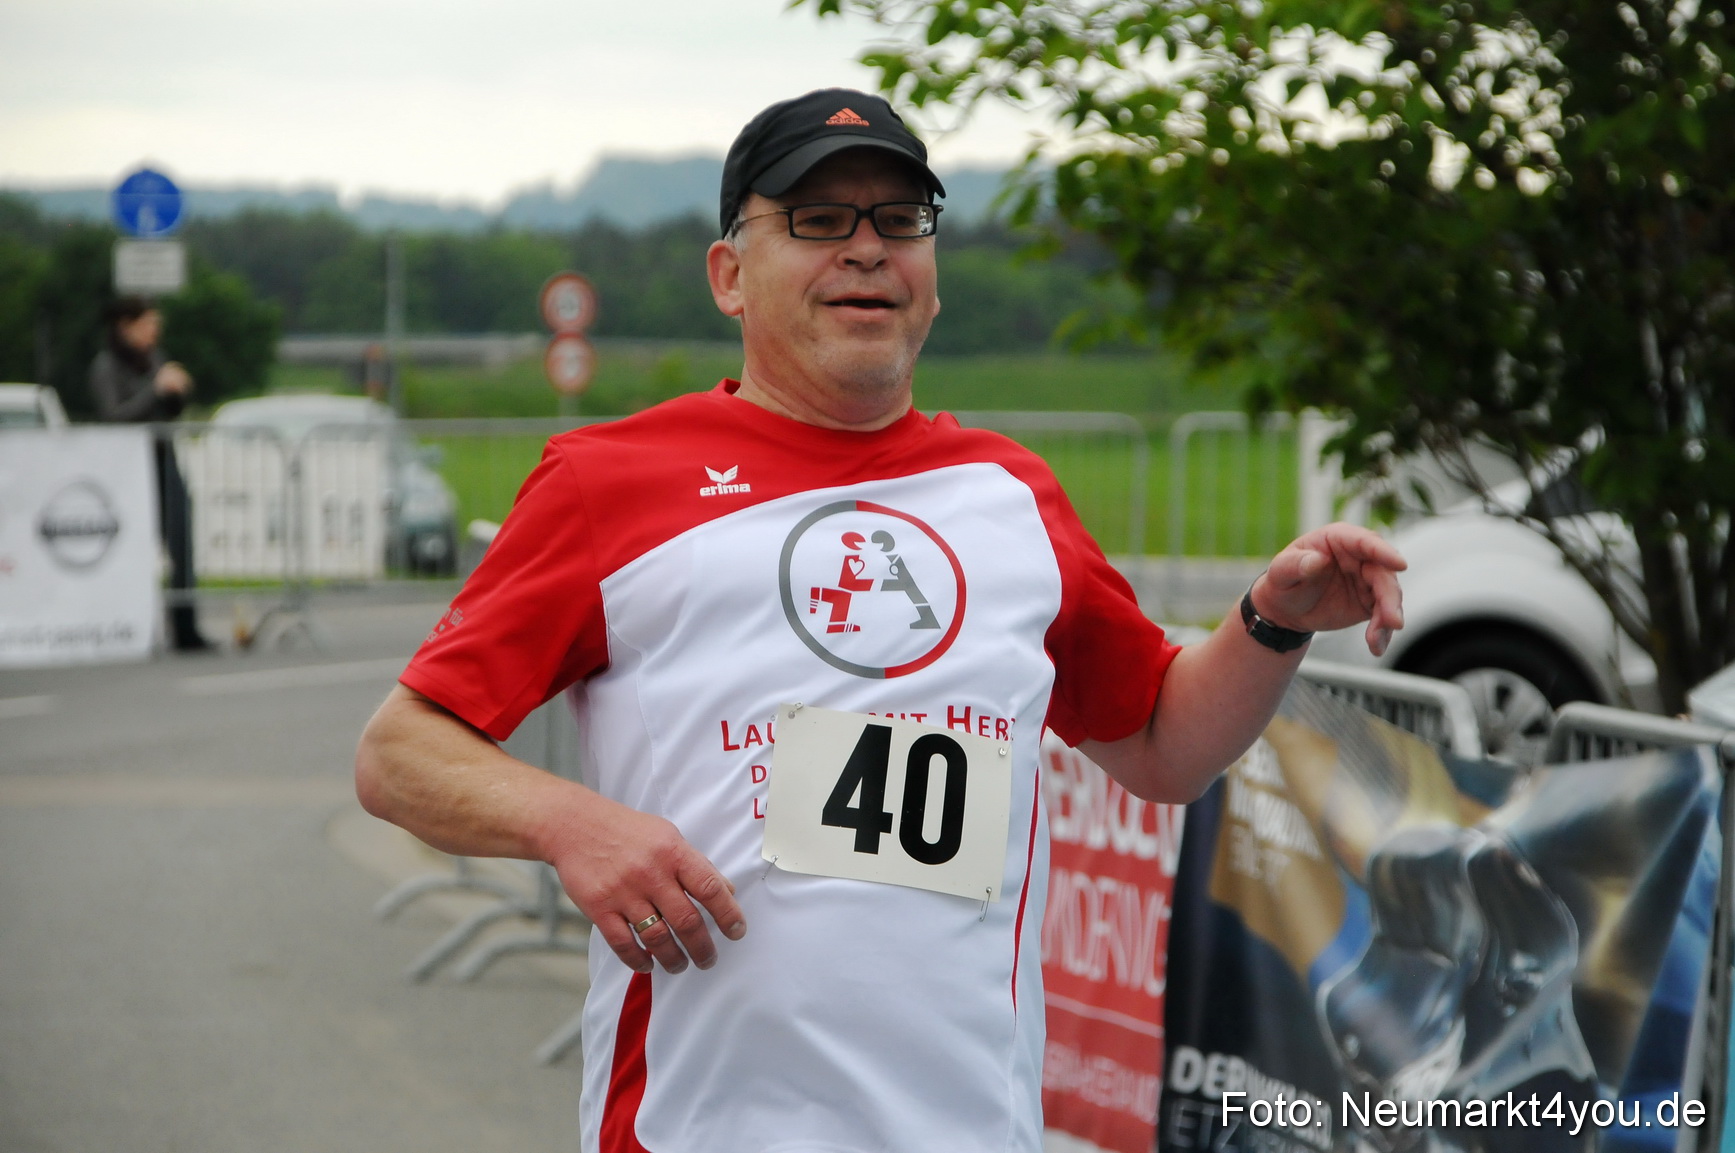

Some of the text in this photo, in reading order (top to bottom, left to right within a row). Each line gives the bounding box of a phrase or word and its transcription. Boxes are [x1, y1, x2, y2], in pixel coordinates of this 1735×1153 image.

[825, 118, 870, 127] adidas
[699, 482, 751, 496] erima
[720, 720, 776, 752] LAU
[820, 723, 968, 866] 40
